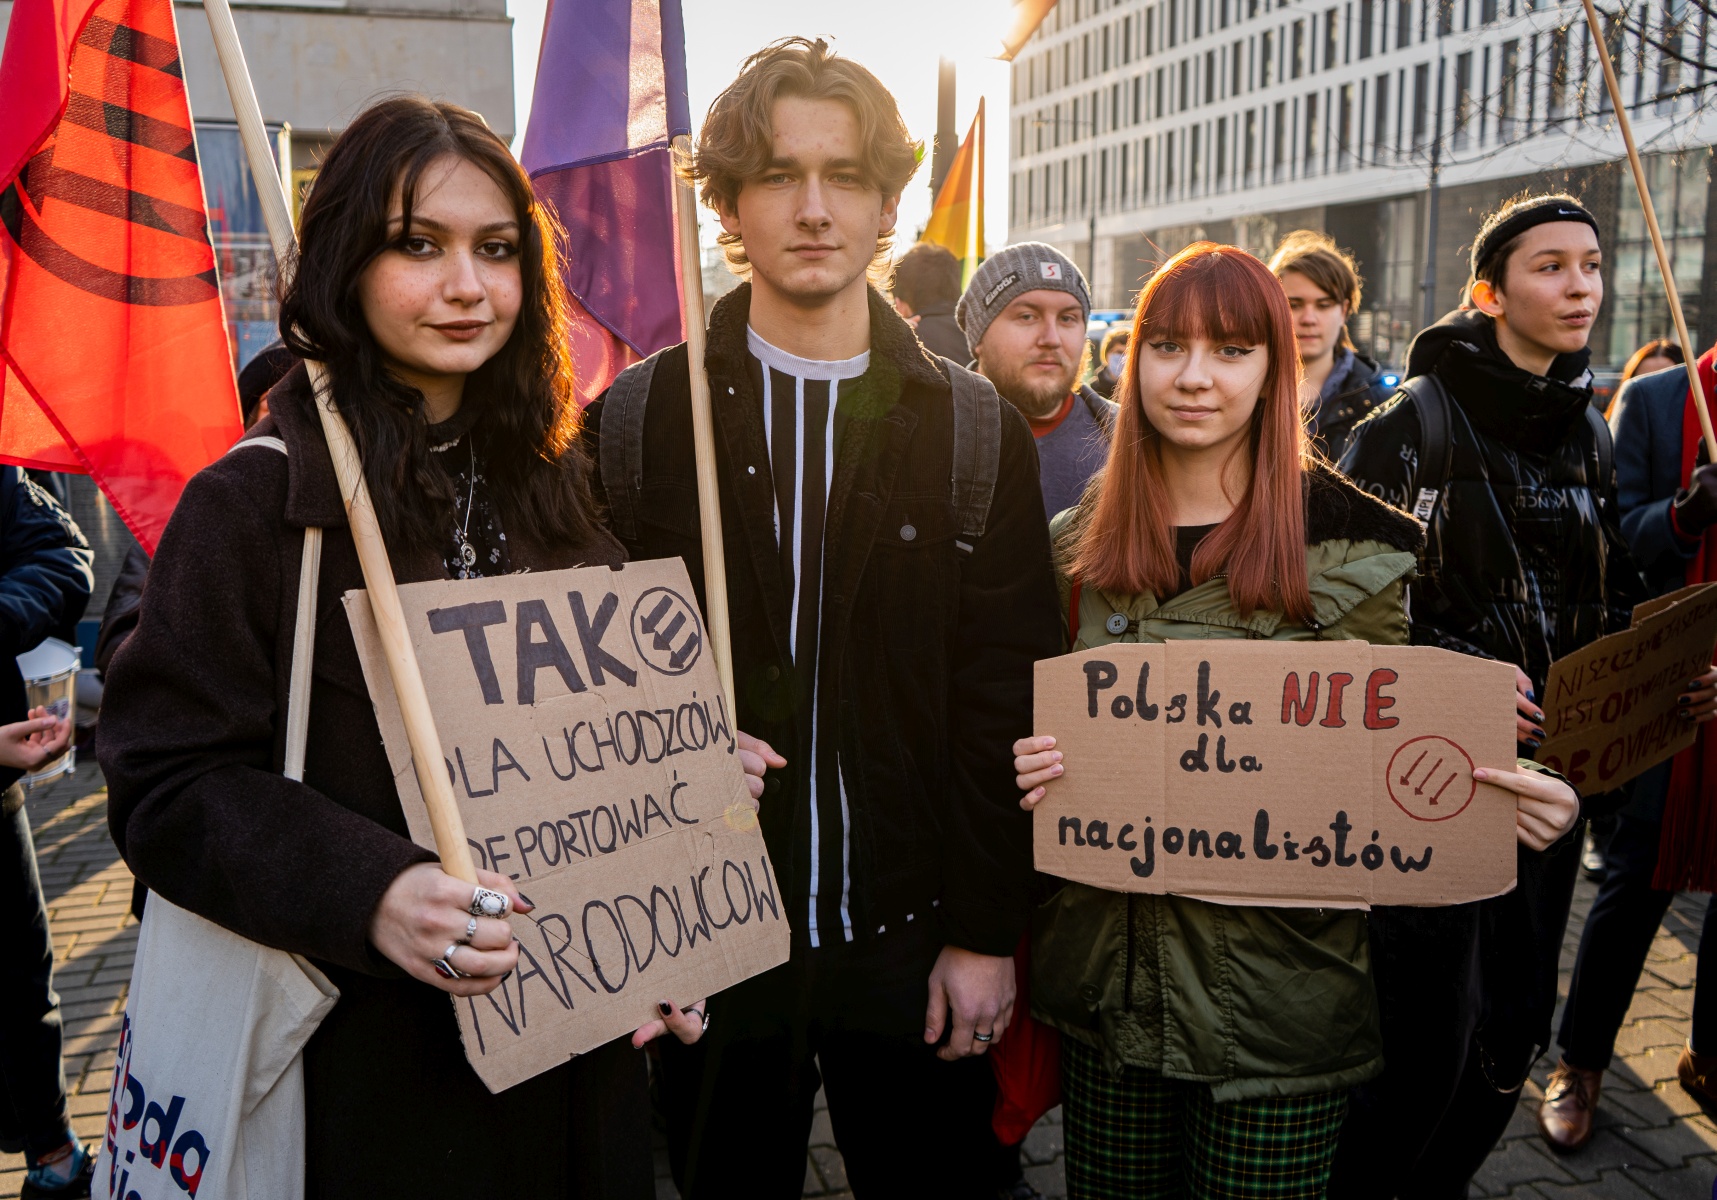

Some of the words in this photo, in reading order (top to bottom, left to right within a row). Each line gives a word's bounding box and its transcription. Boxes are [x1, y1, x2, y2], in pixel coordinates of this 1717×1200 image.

[427, 591, 637, 706] TAK
[1083, 660, 1253, 728] Polska
[1281, 668, 1400, 730] NIE
[1552, 697, 1597, 737] JEST
[1179, 733, 1263, 774] dla
[1058, 809, 1433, 878] nacjonalistów
